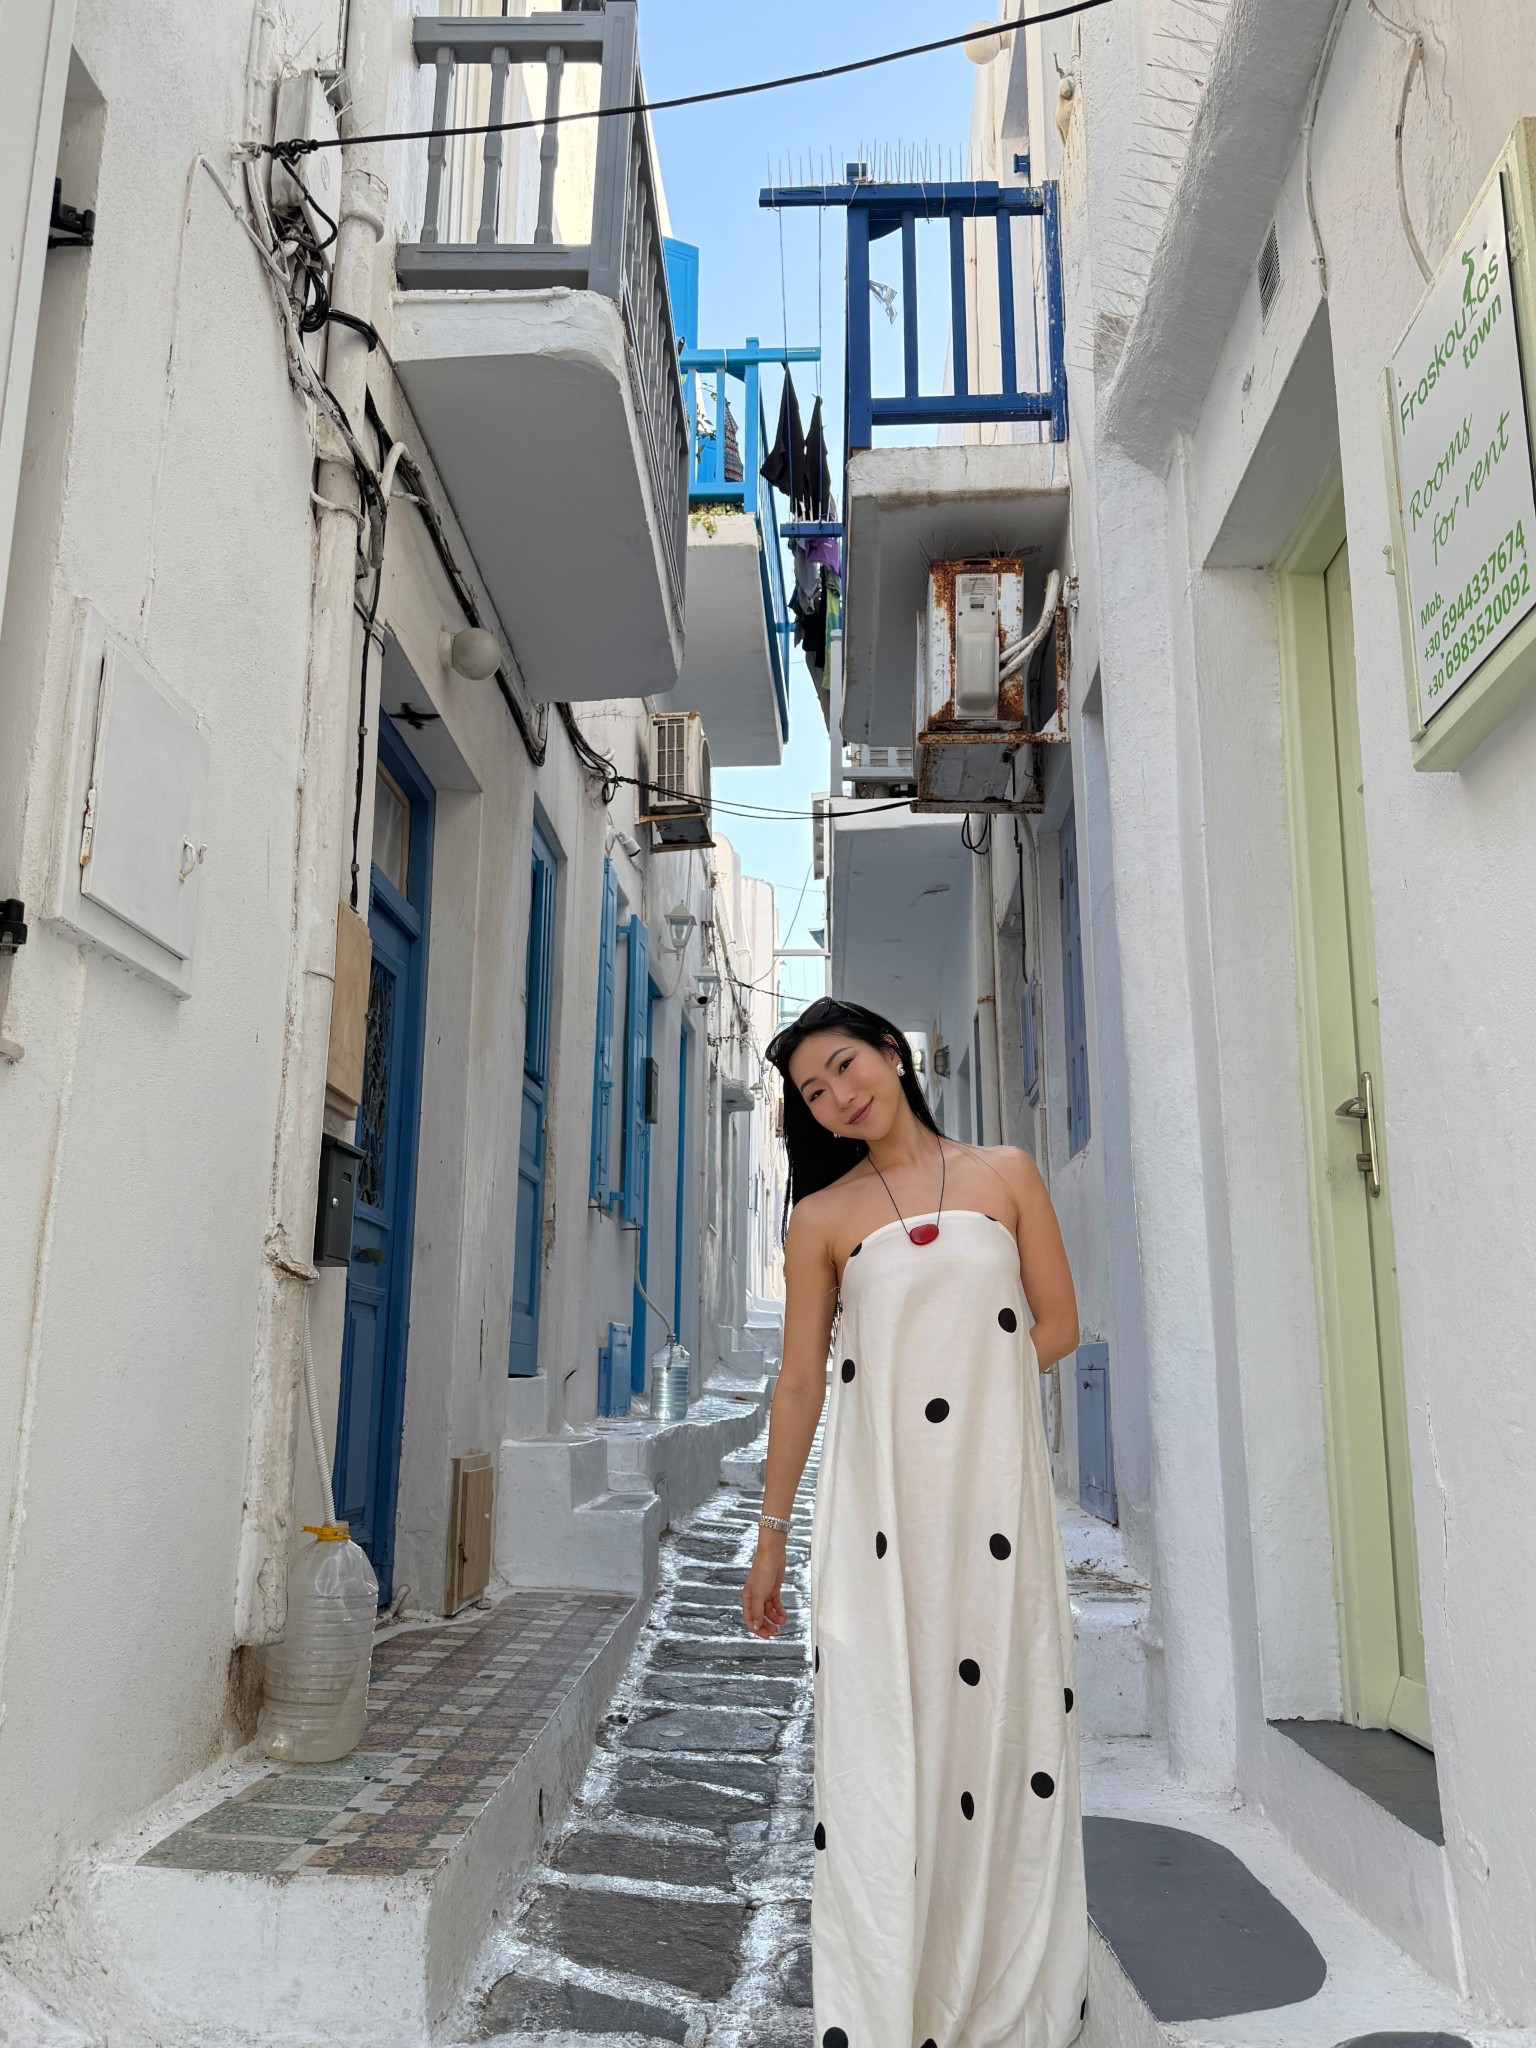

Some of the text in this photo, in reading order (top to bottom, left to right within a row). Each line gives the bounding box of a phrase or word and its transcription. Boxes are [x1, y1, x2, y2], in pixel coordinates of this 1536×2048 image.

[1462, 294, 1502, 369] town
[1410, 413, 1472, 532] Rooms
[1432, 410, 1510, 566] for rent
[1420, 592, 1444, 629] Mob.
[1424, 519, 1525, 662] +30 6944337674
[1428, 562, 1530, 698] +30 6983520092
